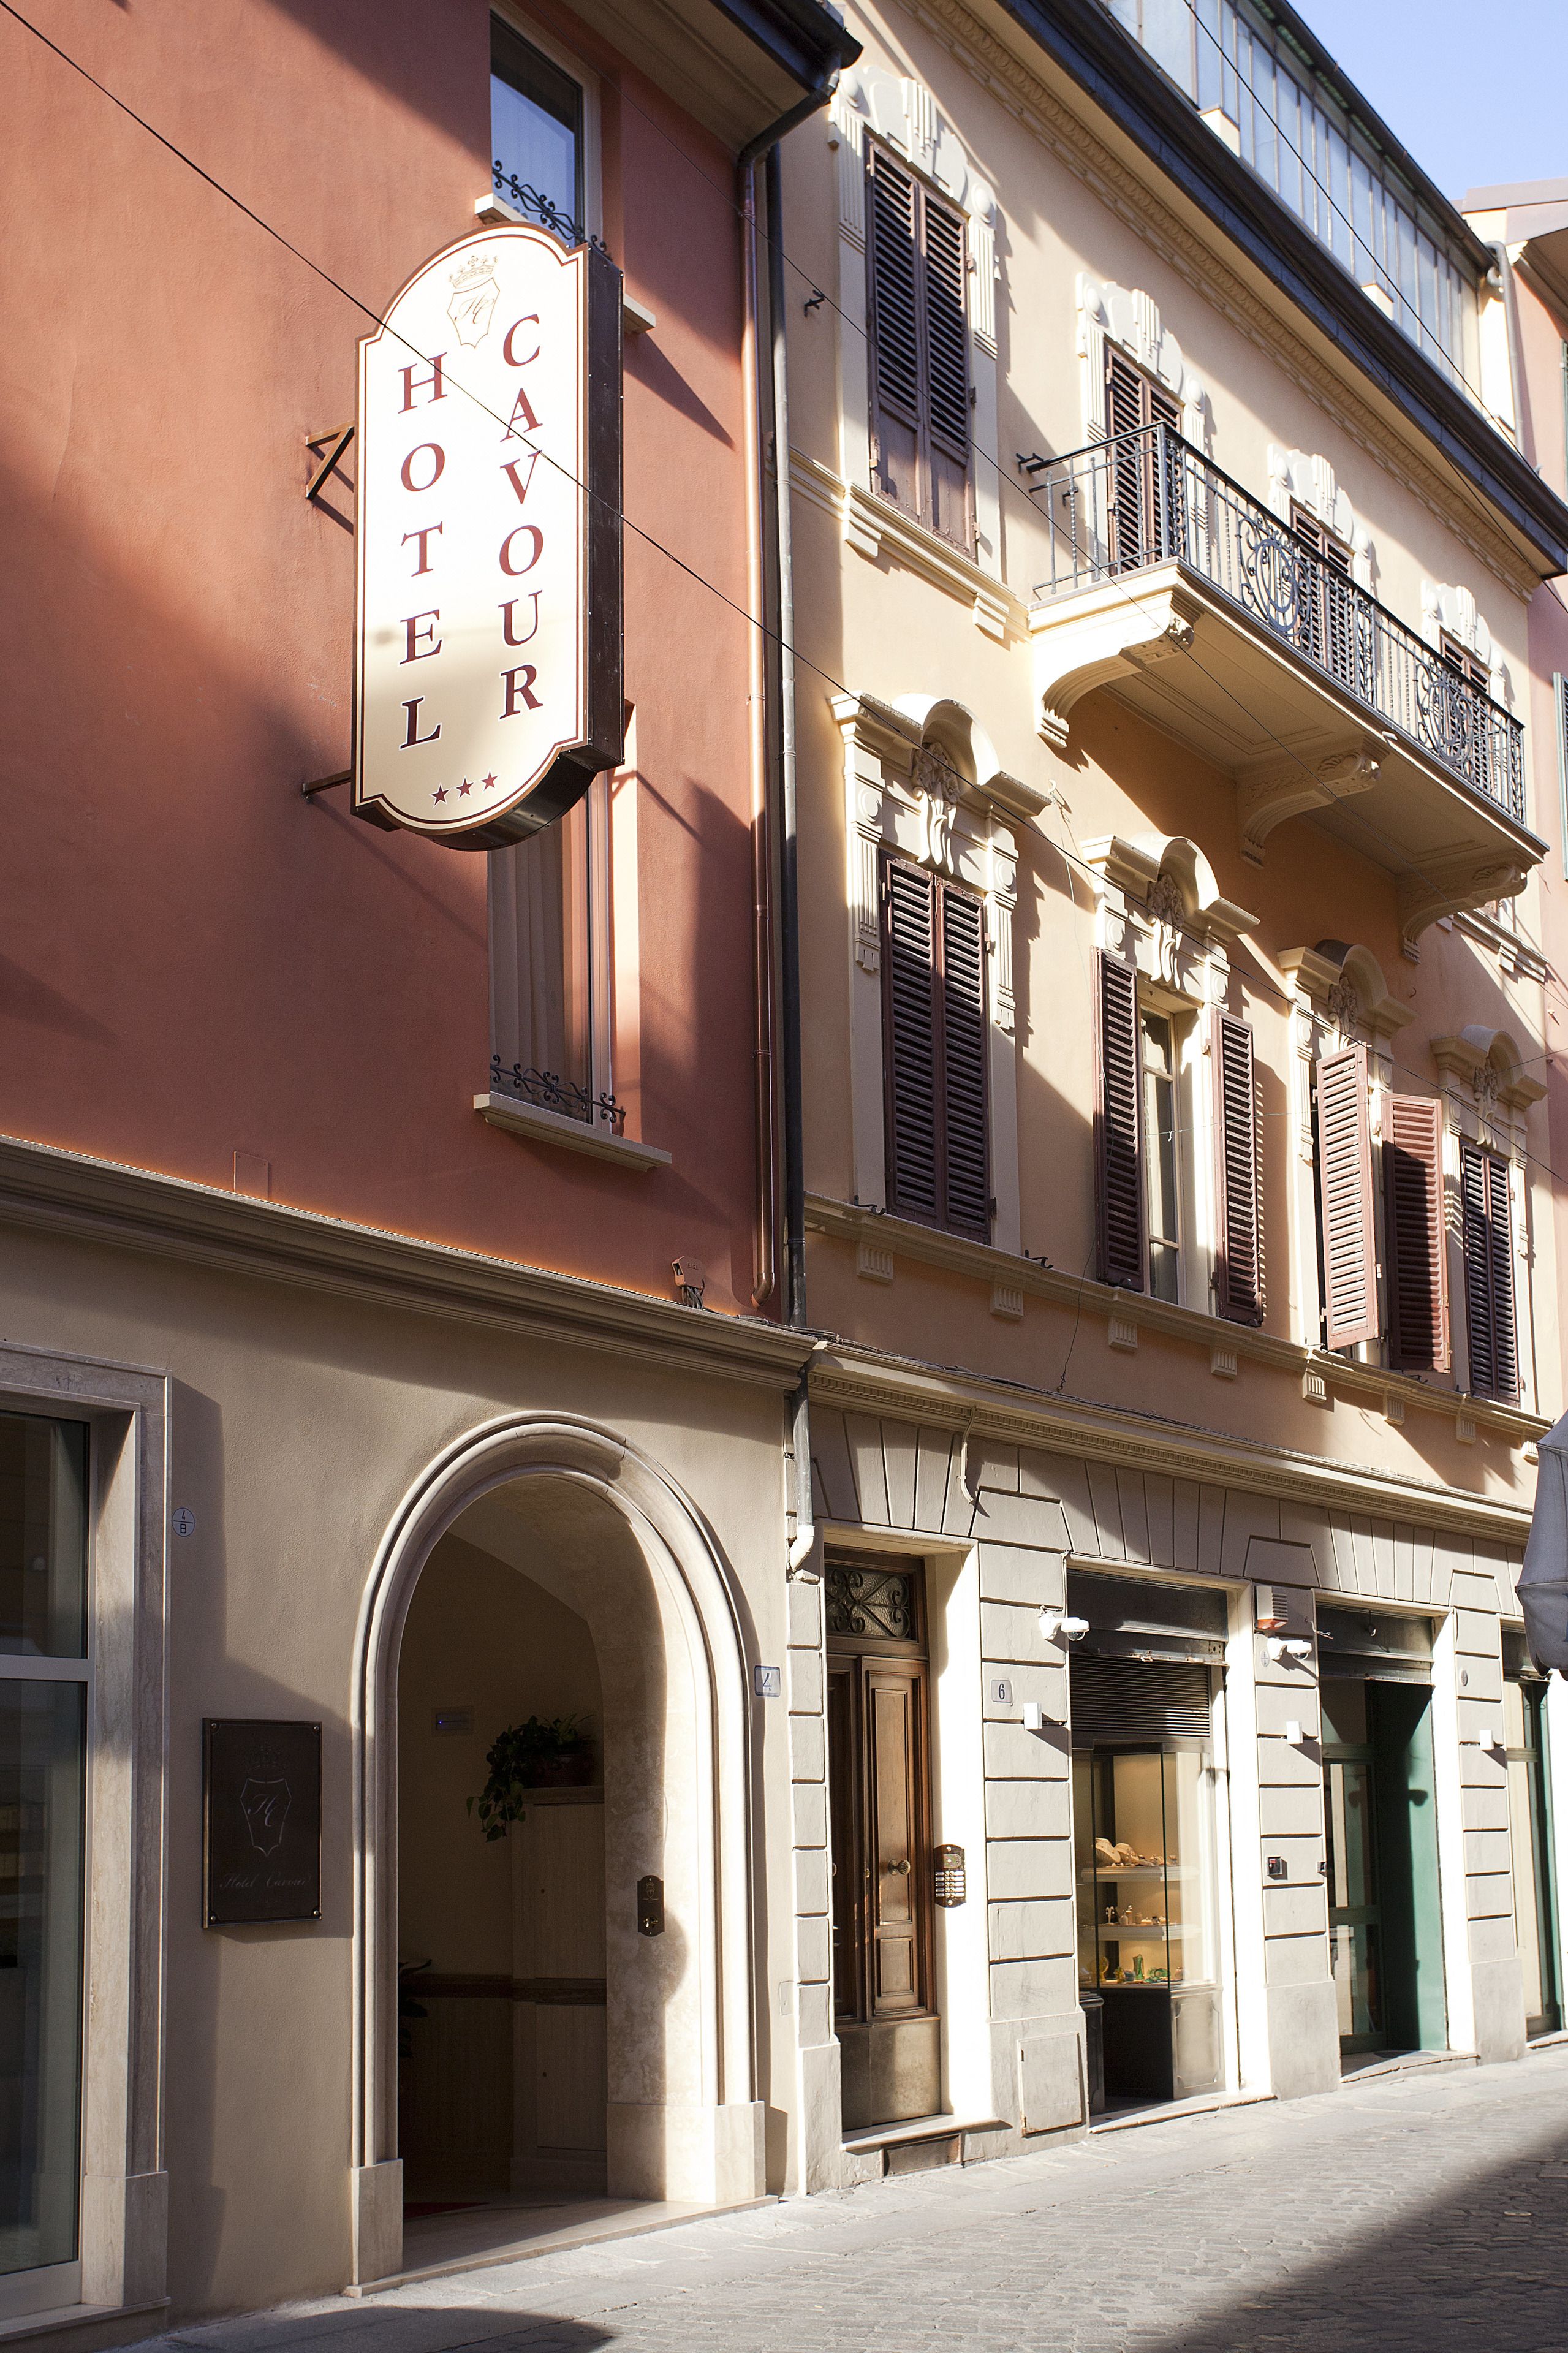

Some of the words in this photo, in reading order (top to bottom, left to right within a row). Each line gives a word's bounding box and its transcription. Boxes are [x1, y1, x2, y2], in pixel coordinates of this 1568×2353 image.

[499, 314, 543, 719] CAVOUR
[398, 352, 448, 749] HOTEL
[181, 1510, 186, 1520] 4
[180, 1523, 187, 1533] B
[998, 1683, 1005, 1699] 6
